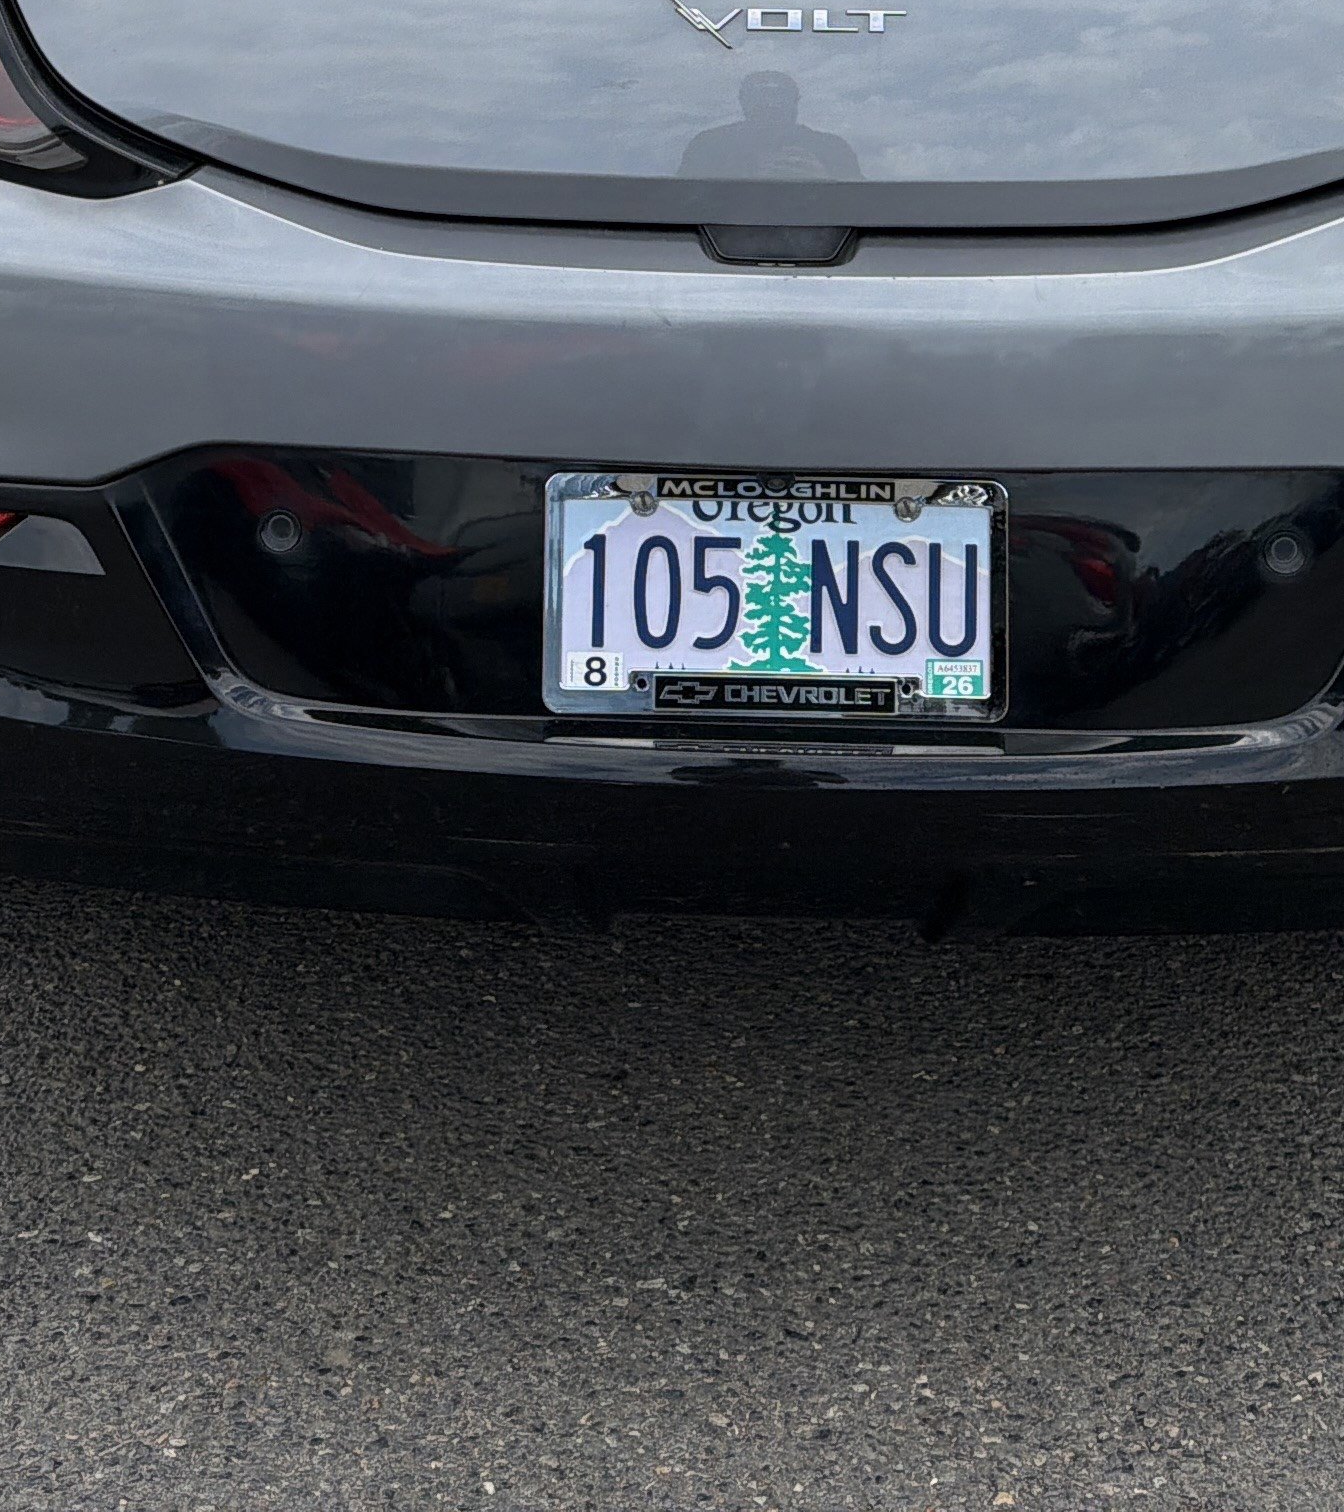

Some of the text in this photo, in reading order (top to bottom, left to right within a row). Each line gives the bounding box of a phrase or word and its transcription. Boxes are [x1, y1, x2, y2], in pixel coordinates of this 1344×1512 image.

[692, 500, 857, 534] Oregon
[583, 532, 978, 658] 105 NSU
[584, 656, 607, 686] 8
[942, 676, 974, 696] 26
[725, 684, 890, 706] CHEVROLET
